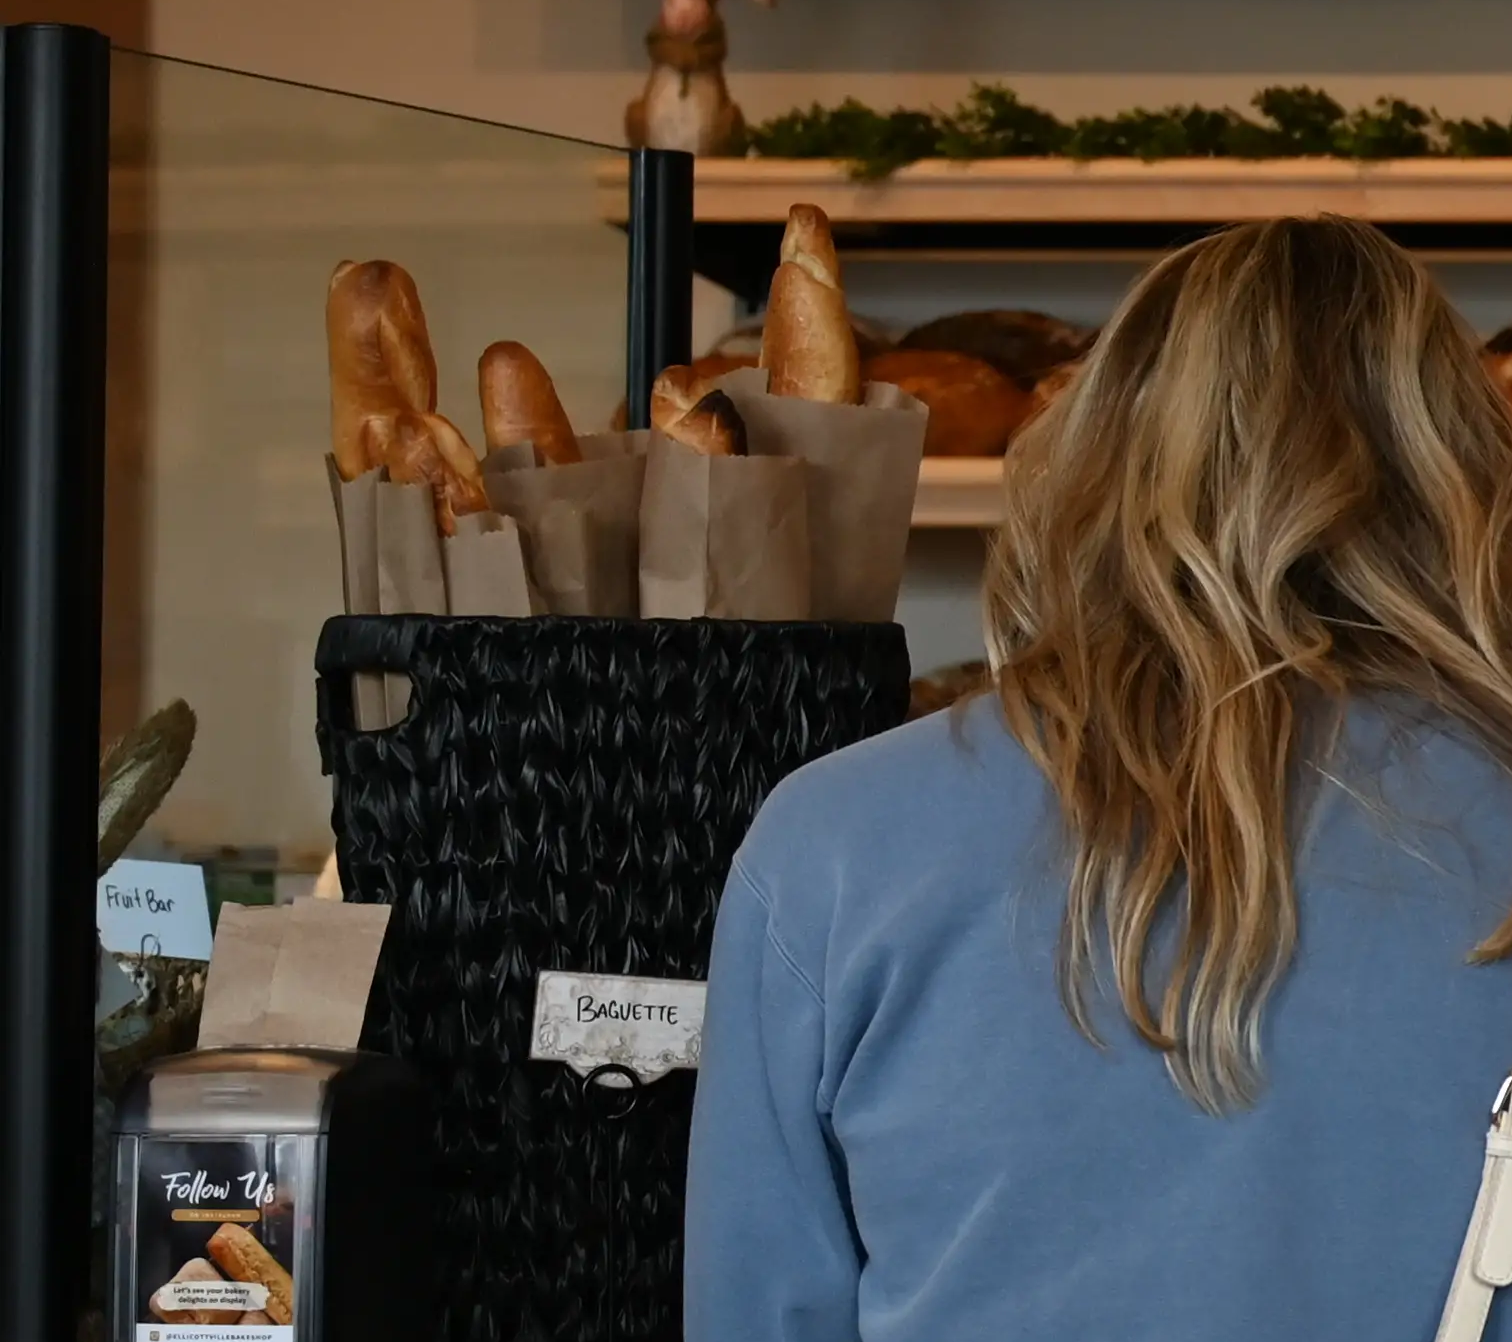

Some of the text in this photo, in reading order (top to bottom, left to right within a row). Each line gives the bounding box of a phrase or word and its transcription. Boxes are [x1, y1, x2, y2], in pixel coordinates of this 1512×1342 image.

[104, 883, 176, 913] Fruit Bar
[576, 993, 679, 1027] BAGUETTE
[161, 1170, 276, 1208] Follow Us
